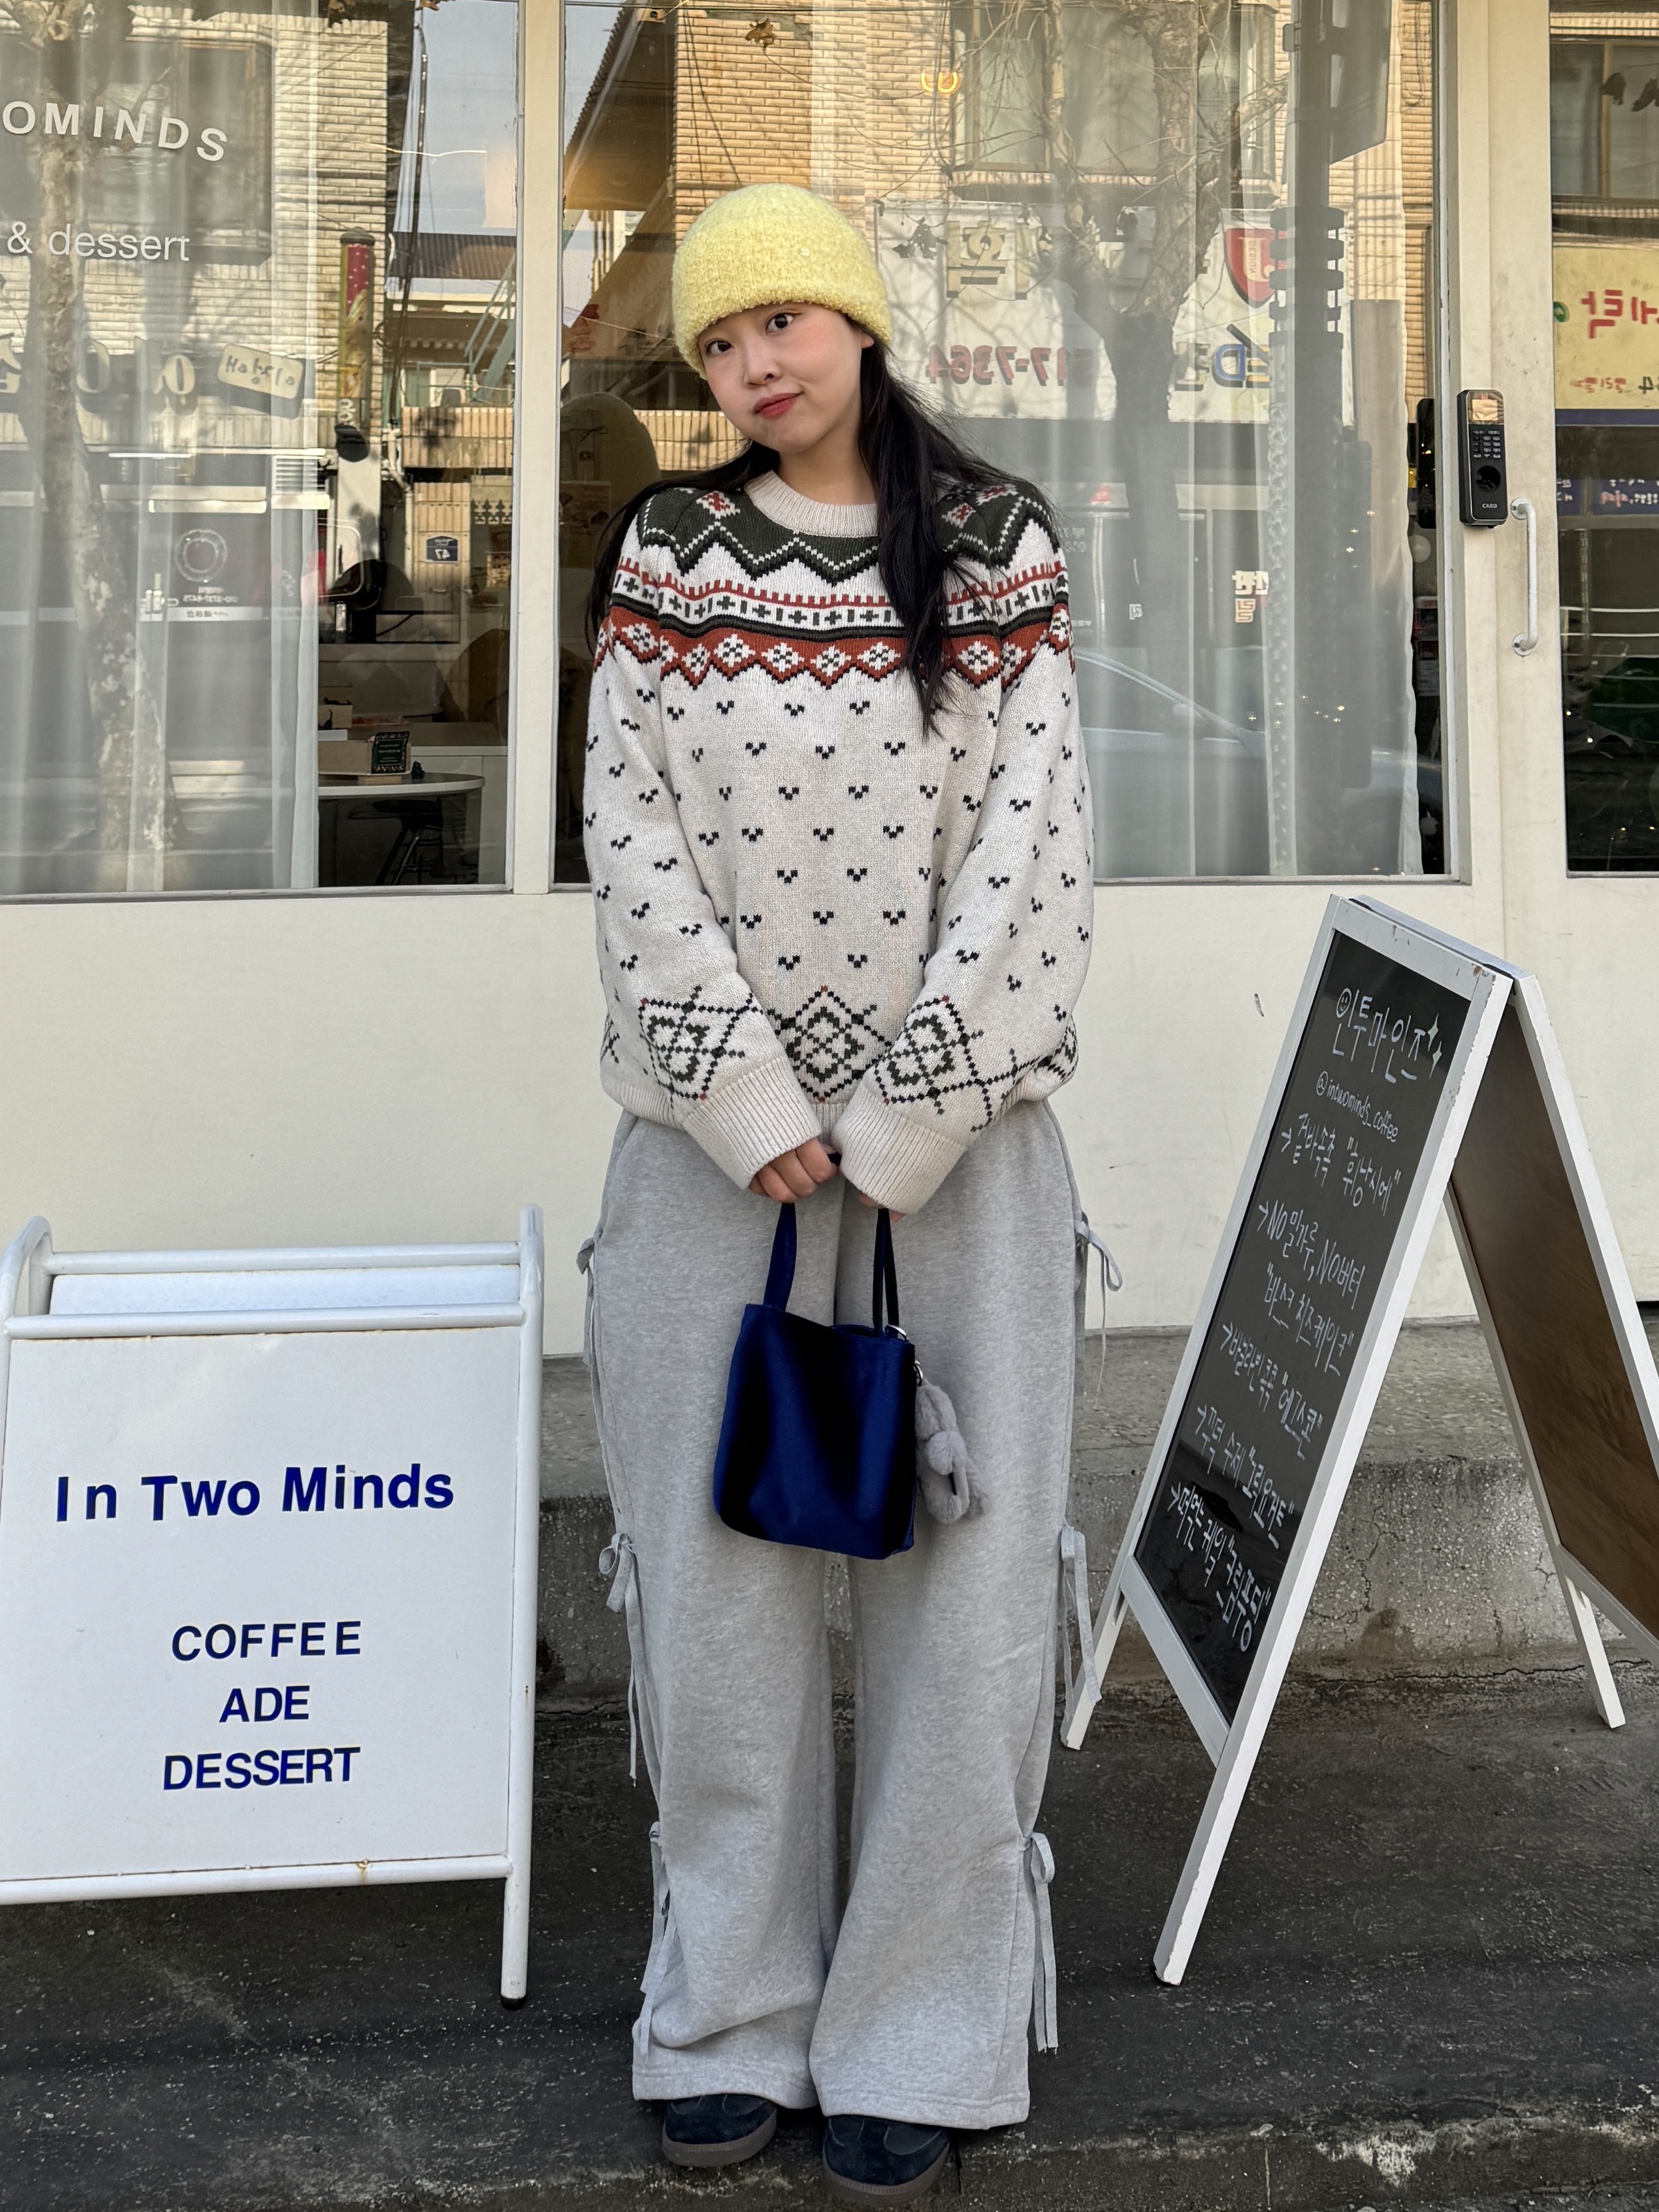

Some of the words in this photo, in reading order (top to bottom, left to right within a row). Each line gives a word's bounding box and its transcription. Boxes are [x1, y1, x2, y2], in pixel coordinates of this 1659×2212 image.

[2, 100, 227, 162] OMINDS
[7, 221, 33, 254] &
[49, 223, 190, 262] dessert
[1332, 987, 1426, 1083] 인투마인즈
[57, 1476, 117, 1522] In
[141, 1475, 261, 1521] Two
[282, 1463, 454, 1512] Minds
[172, 1621, 361, 1661] COFFEE
[219, 1685, 311, 1723] ADE
[163, 1747, 360, 1790] DESSERT
